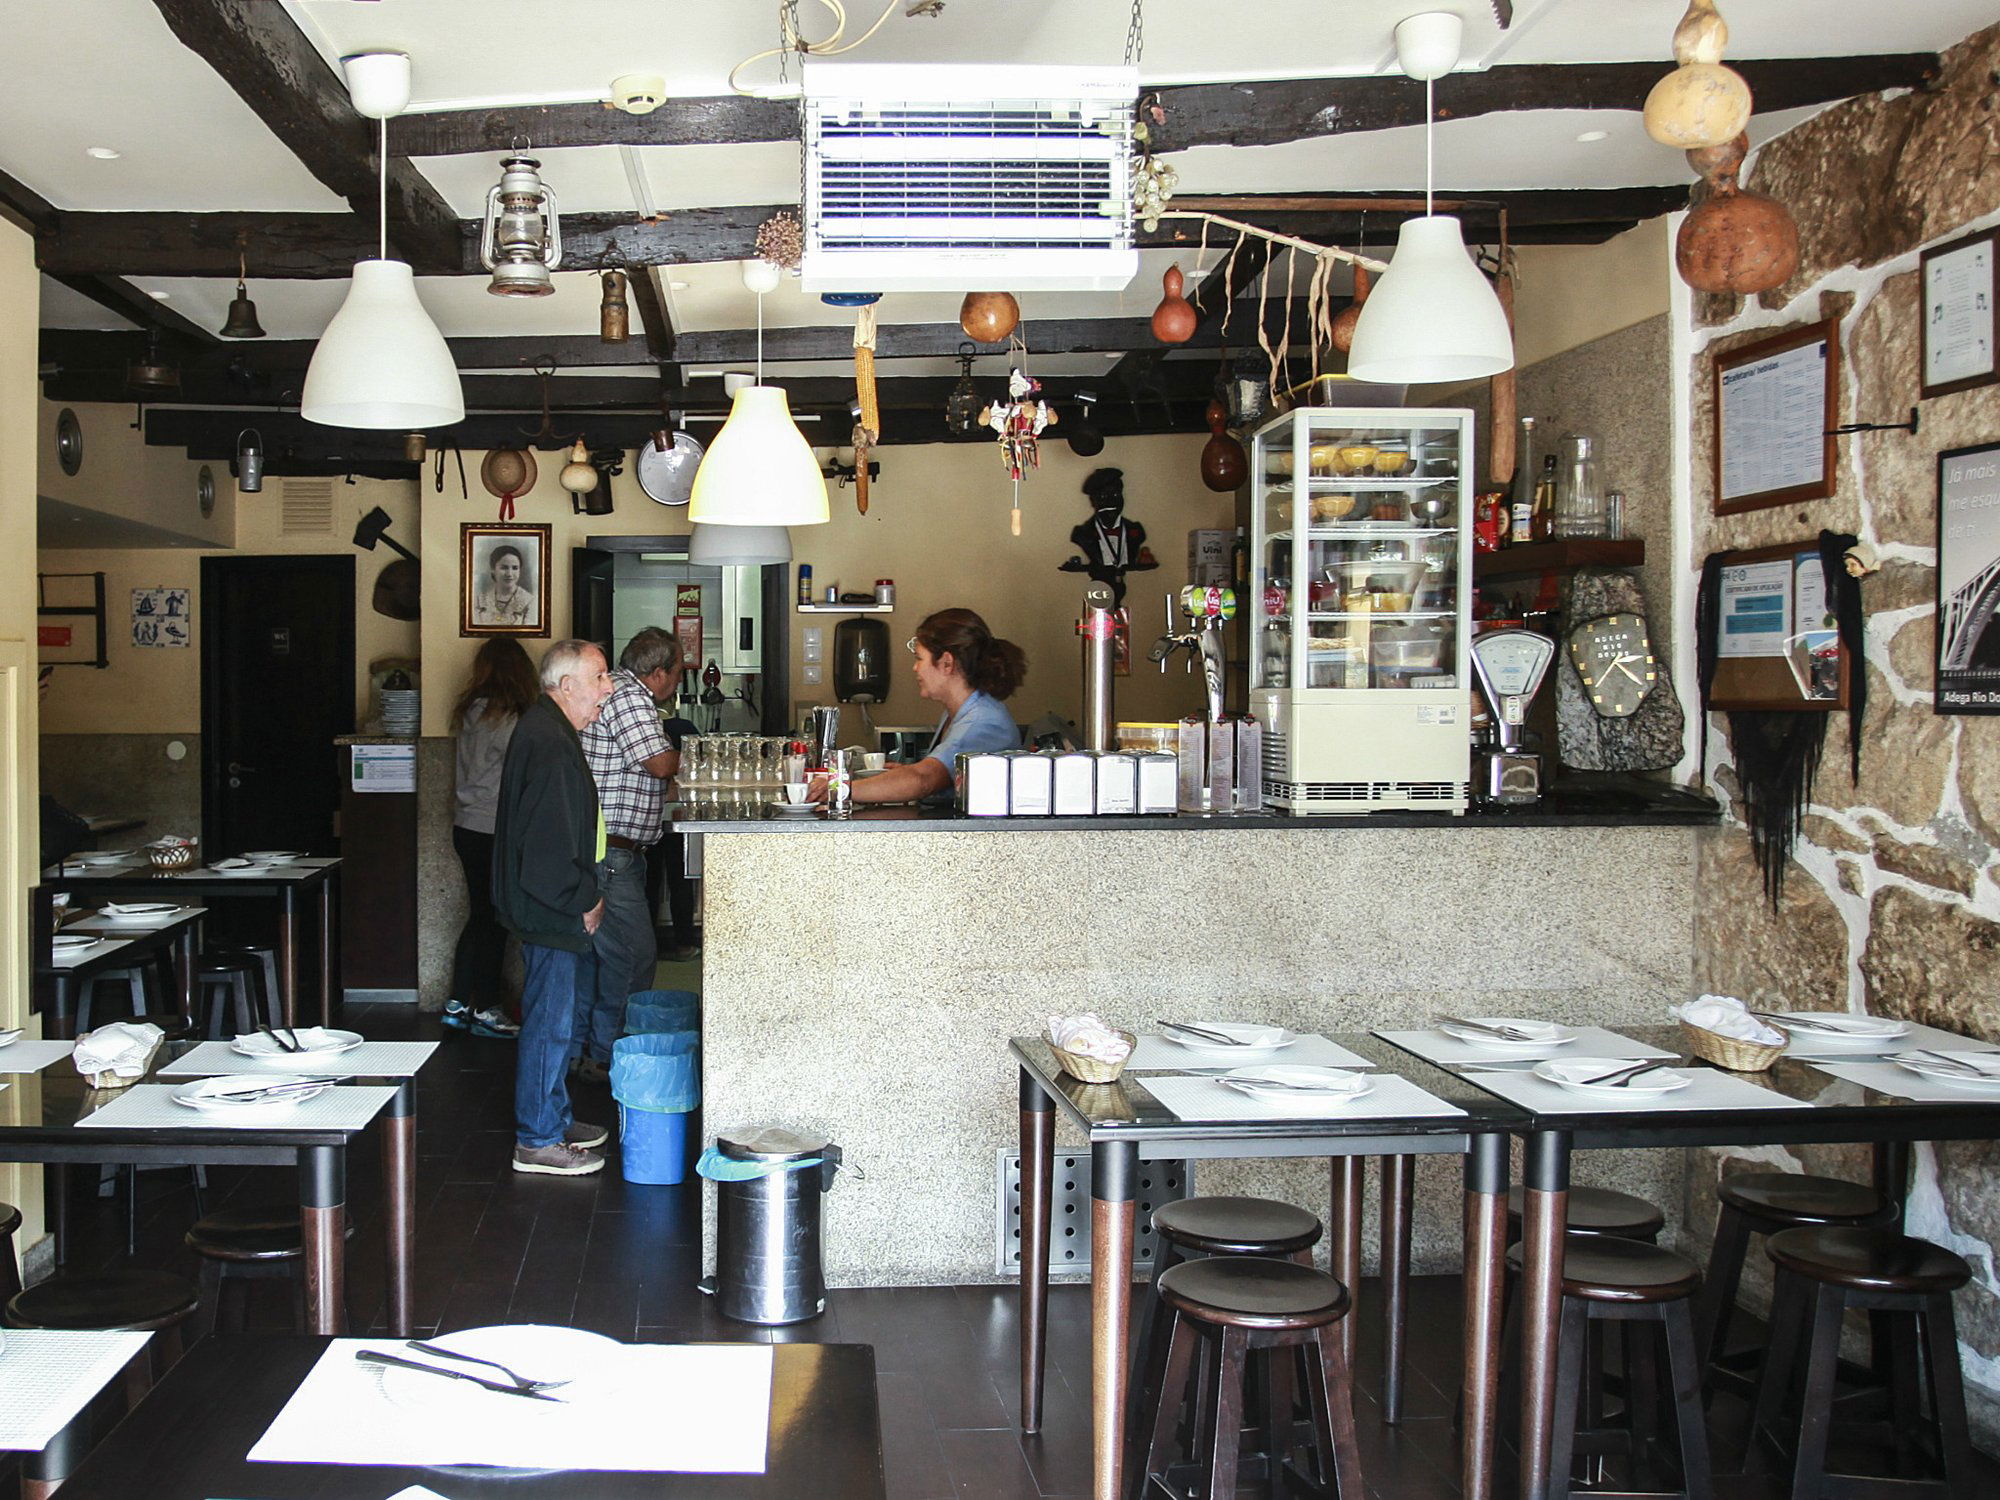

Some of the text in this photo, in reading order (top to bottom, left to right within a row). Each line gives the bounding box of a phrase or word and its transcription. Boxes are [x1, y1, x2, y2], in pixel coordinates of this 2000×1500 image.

[1948, 462, 1996, 484] Já mais
[1949, 497, 1968, 511] me
[1087, 590, 1111, 599] ICE
[274, 632, 287, 640] WC
[1595, 633, 1628, 643] ADEGA
[1602, 643, 1622, 651] RIO
[1943, 691, 2000, 705] Adega Rio Do
